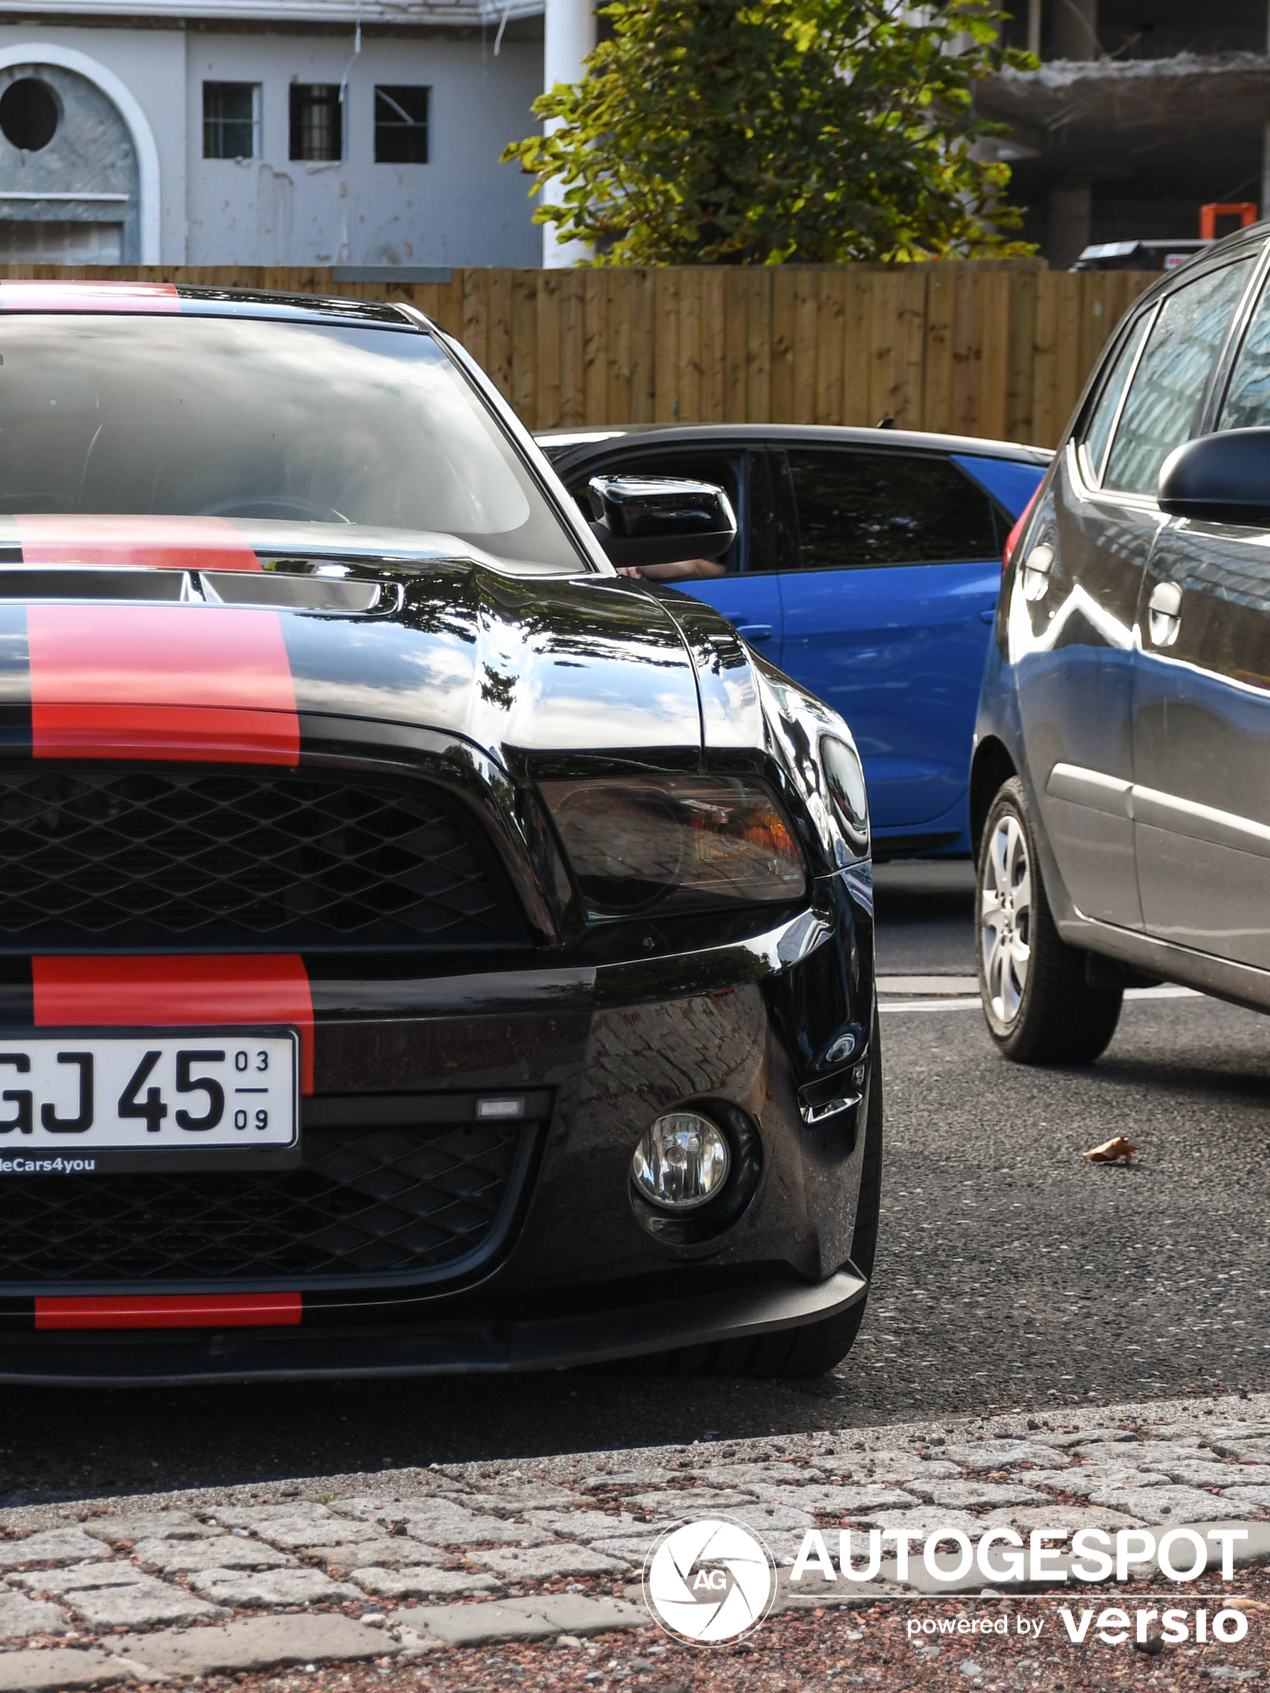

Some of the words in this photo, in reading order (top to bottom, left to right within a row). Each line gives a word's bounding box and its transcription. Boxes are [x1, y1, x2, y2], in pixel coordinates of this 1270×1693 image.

[235, 1050, 270, 1072] 03
[117, 1049, 226, 1133] 45
[234, 1109, 269, 1131] 09
